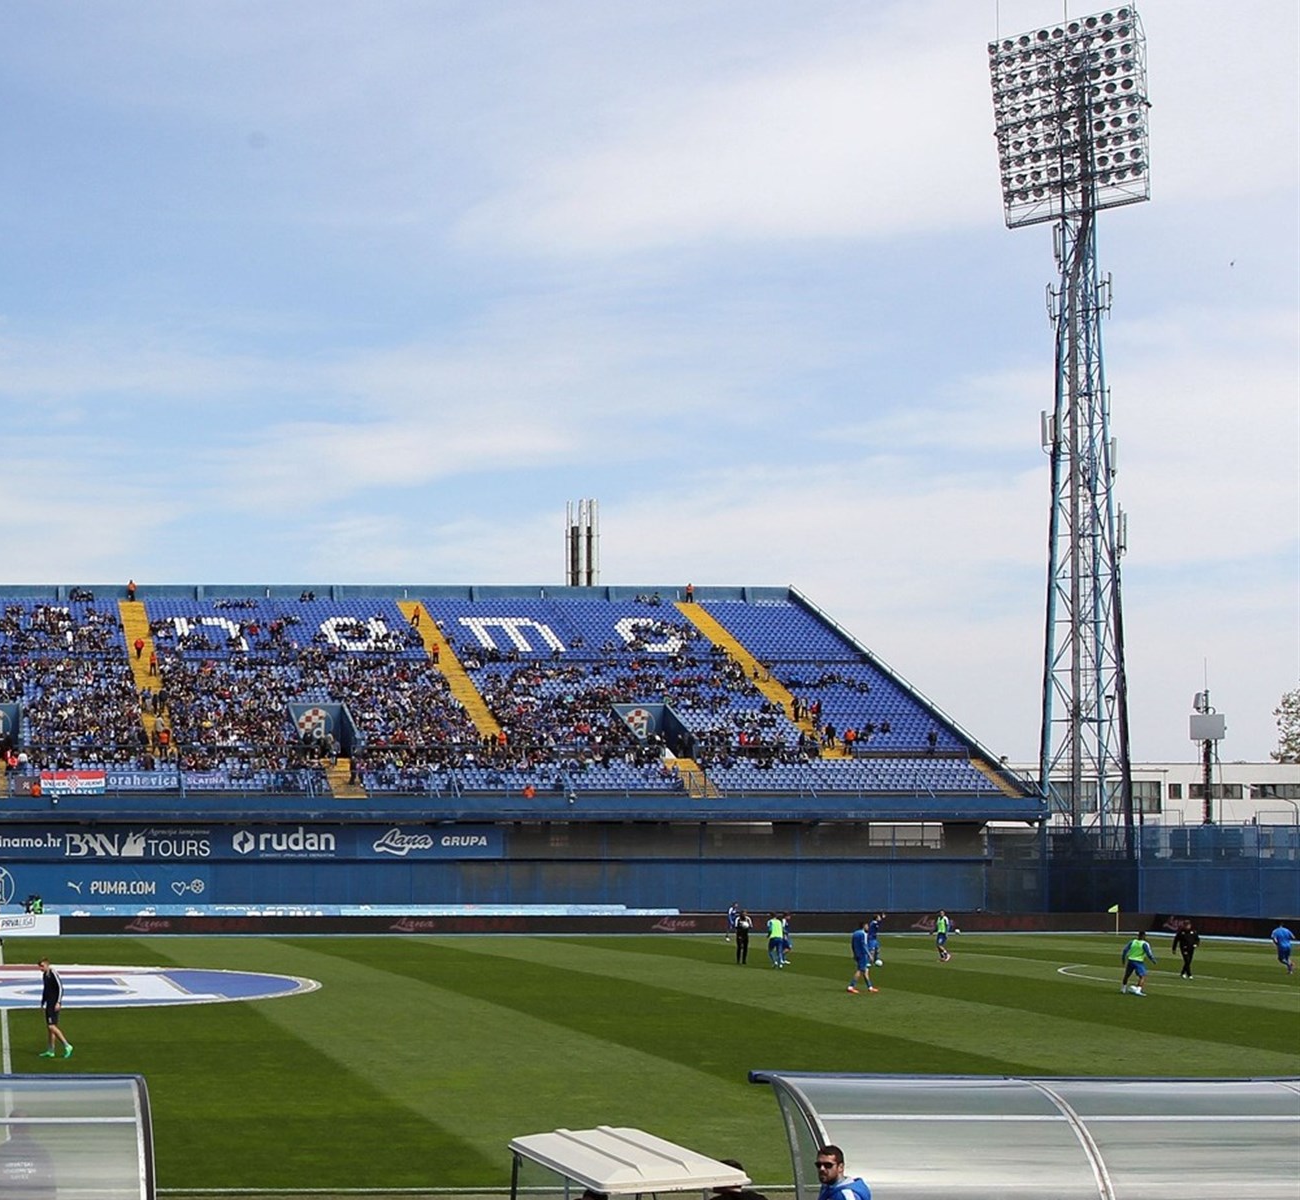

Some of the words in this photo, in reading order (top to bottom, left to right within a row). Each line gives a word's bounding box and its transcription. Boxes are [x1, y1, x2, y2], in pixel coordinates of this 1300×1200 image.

[109, 773, 178, 788] orahovica
[259, 826, 336, 851] rudan
[441, 835, 488, 847] GRUPA
[148, 839, 211, 858] TOURS
[89, 881, 156, 895] PUMA.COM
